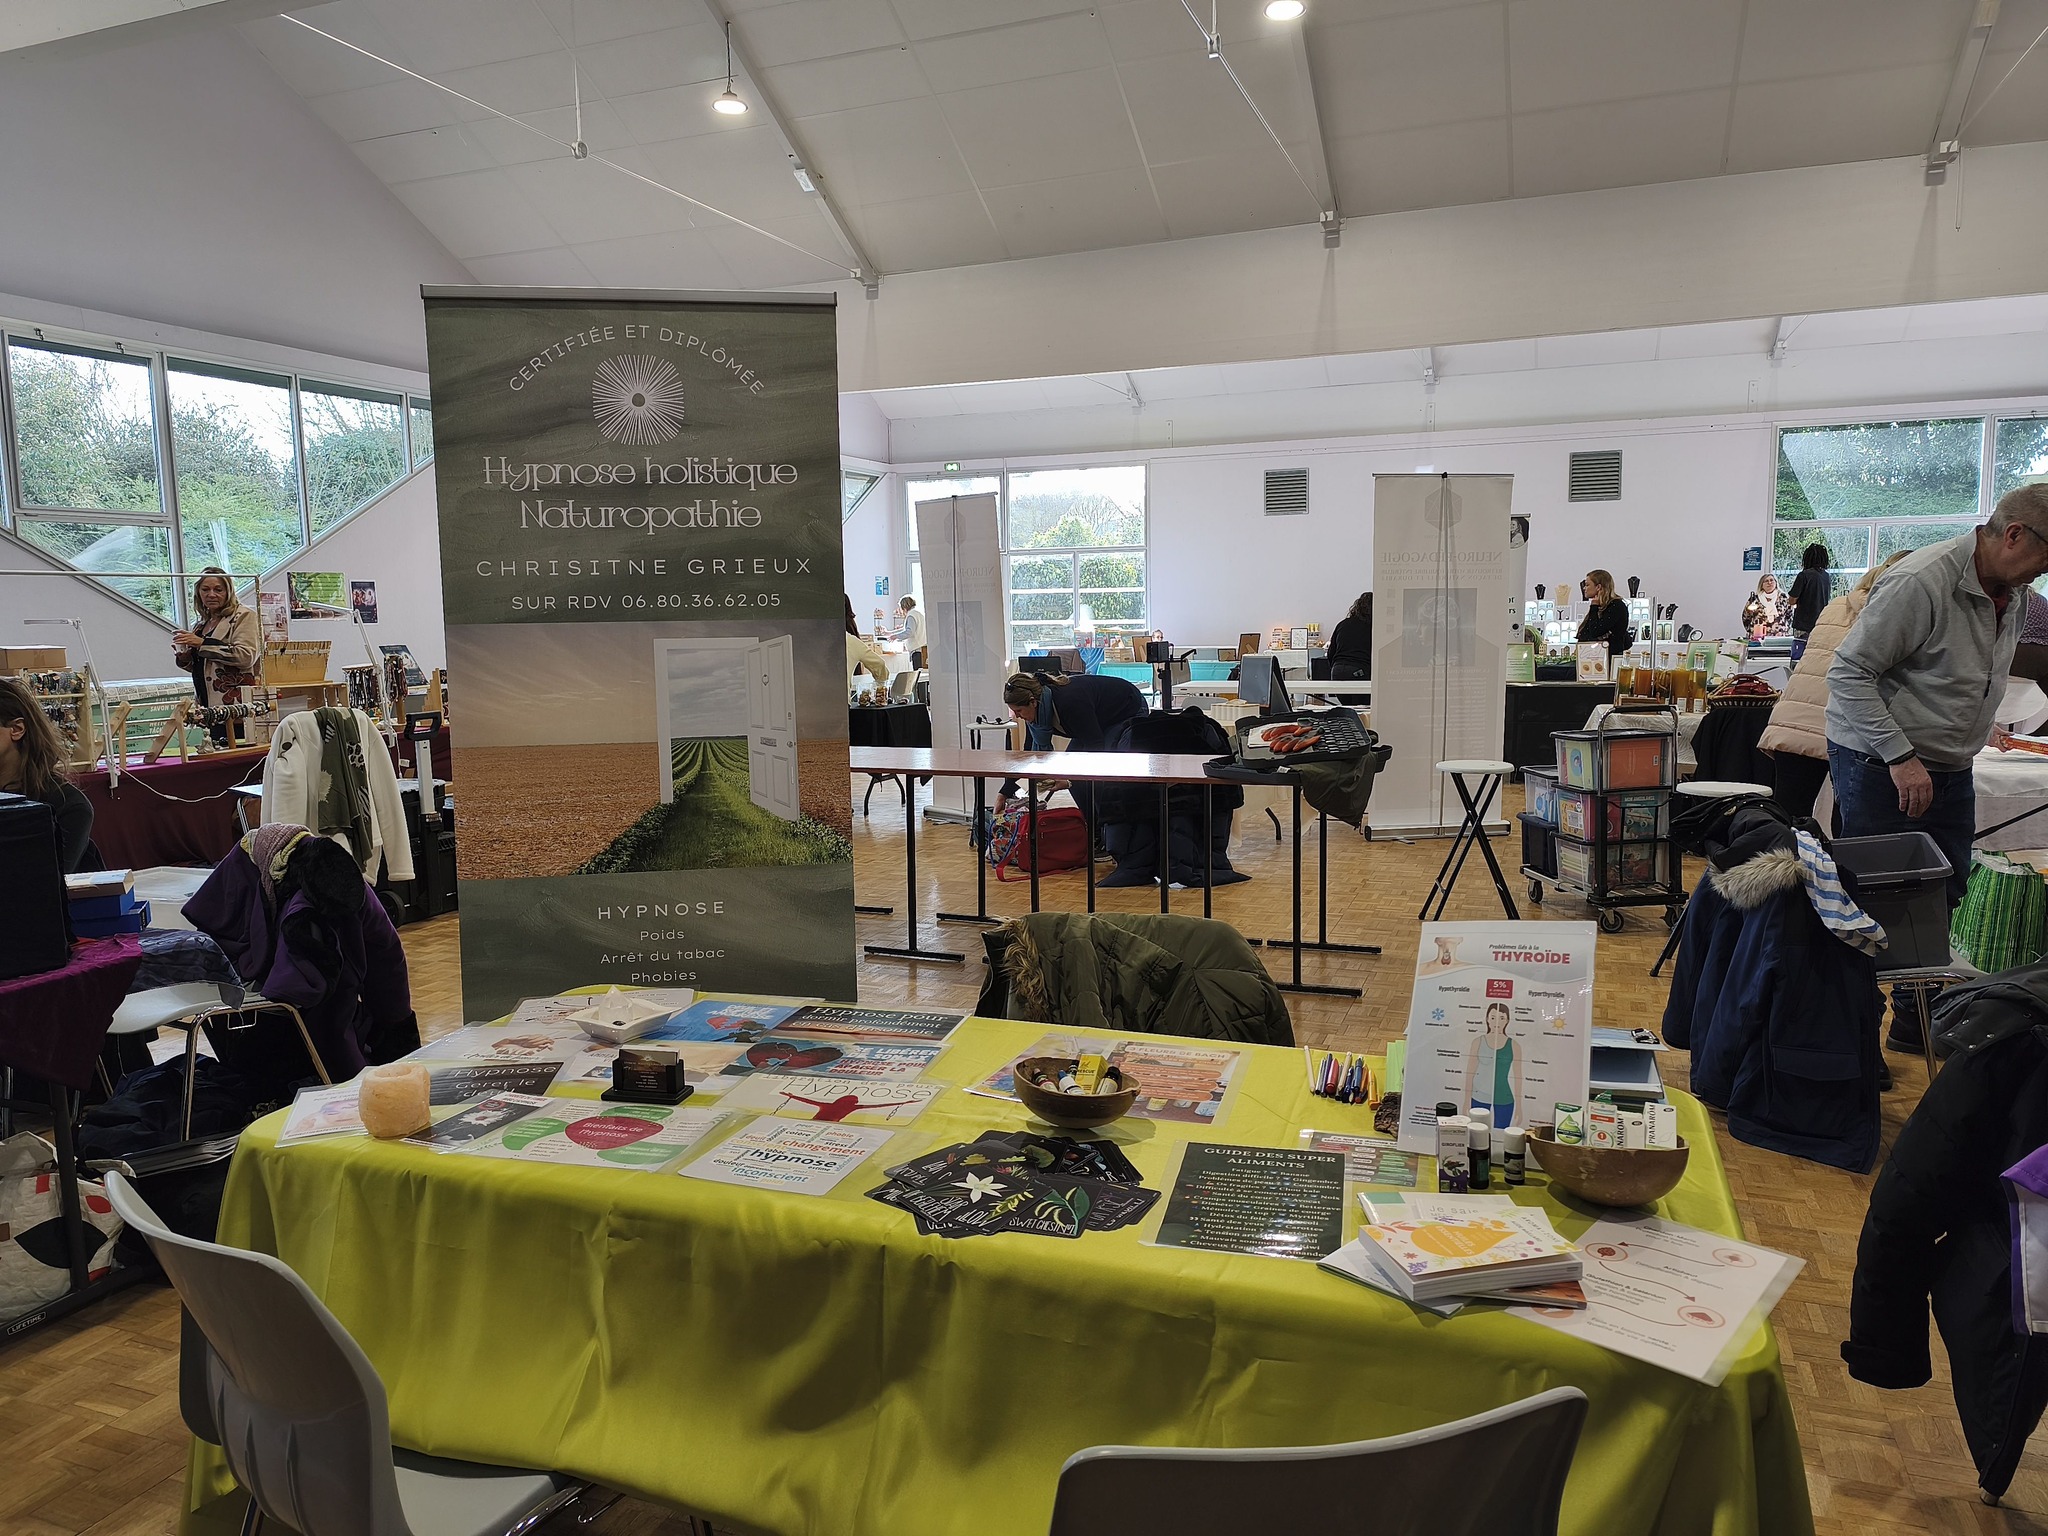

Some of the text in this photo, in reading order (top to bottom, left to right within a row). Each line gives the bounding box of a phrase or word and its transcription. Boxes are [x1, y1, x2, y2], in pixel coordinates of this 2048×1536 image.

[509, 324, 765, 395] CERTIFIÉE ET DIPLÔMÉE
[483, 456, 798, 492] Hypnose holistique
[520, 499, 762, 535] Naturopathie
[476, 558, 811, 577] CHRISITNE GRIEUX
[511, 593, 781, 610] SUR RDV 06.80.36.62.05
[597, 901, 724, 920] HYPNOSE
[640, 929, 685, 941] Poids
[600, 948, 725, 964] Arrêt du tabac
[1492, 949, 1571, 964] THYROÏDE
[631, 970, 697, 983] Phobies
[1492, 980, 1507, 988] 5%
[802, 1014, 942, 1028] dormir profondément
[812, 1007, 949, 1022] Hypnose pour
[845, 1024, 934, 1035] d'insomnie
[876, 1047, 940, 1056] LIBÉRER
[1138, 1047, 1177, 1055] FLEURS
[838, 1059, 895, 1067] HYPNOSE
[453, 1066, 558, 1078] Hypnose
[518, 1078, 536, 1086] le
[782, 1079, 933, 1101] Hypnose
[583, 1122, 628, 1132] Bienfaits
[785, 1129, 811, 1137] colère
[782, 1139, 866, 1156] changement
[1204, 1147, 1337, 1163] GUIDE DES SUPER
[713, 1158, 746, 1167] douleur
[750, 1148, 838, 1168] hypnose
[1226, 1157, 1306, 1169] ALIMENTS
[731, 1167, 809, 1183] inconscient
[1203, 1223, 1257, 1232] Hydratation
[1585, 1272, 1624, 1288] Glutathion
[12, 1314, 42, 1332] LIFETIME
